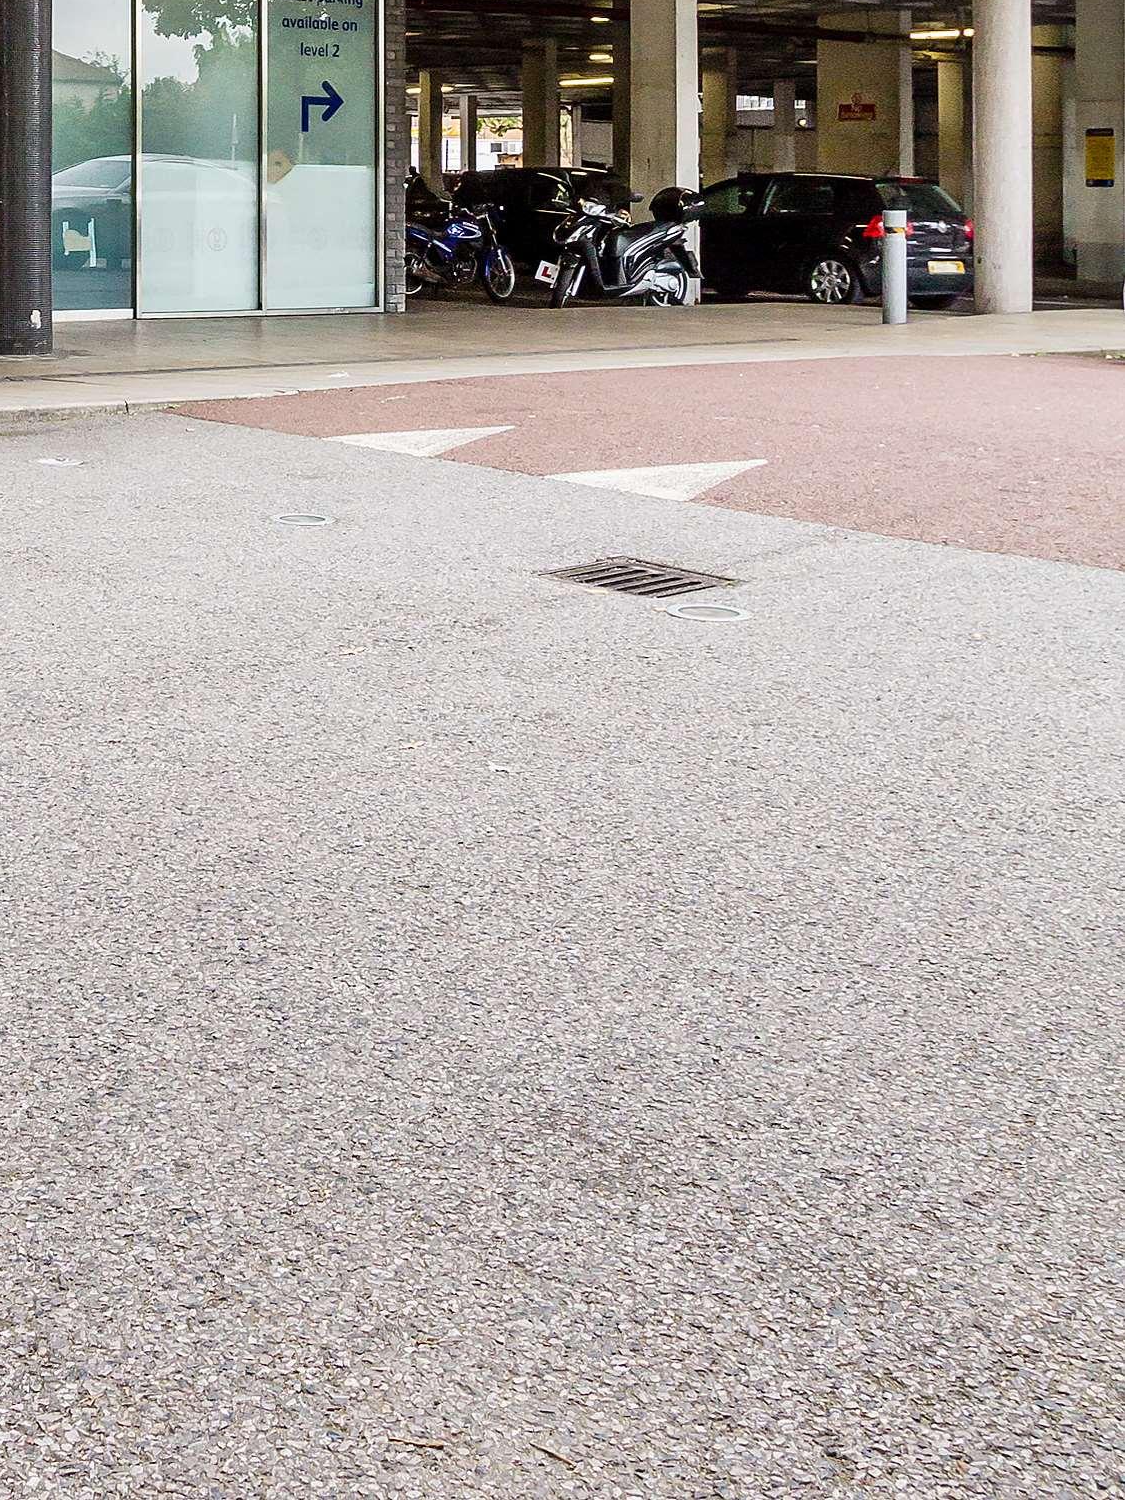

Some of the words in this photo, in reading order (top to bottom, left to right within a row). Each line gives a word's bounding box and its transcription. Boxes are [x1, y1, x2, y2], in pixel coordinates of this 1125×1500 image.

[282, 16, 339, 31] available
[342, 20, 358, 31] on
[300, 42, 328, 57] level
[332, 43, 340, 57] 2
